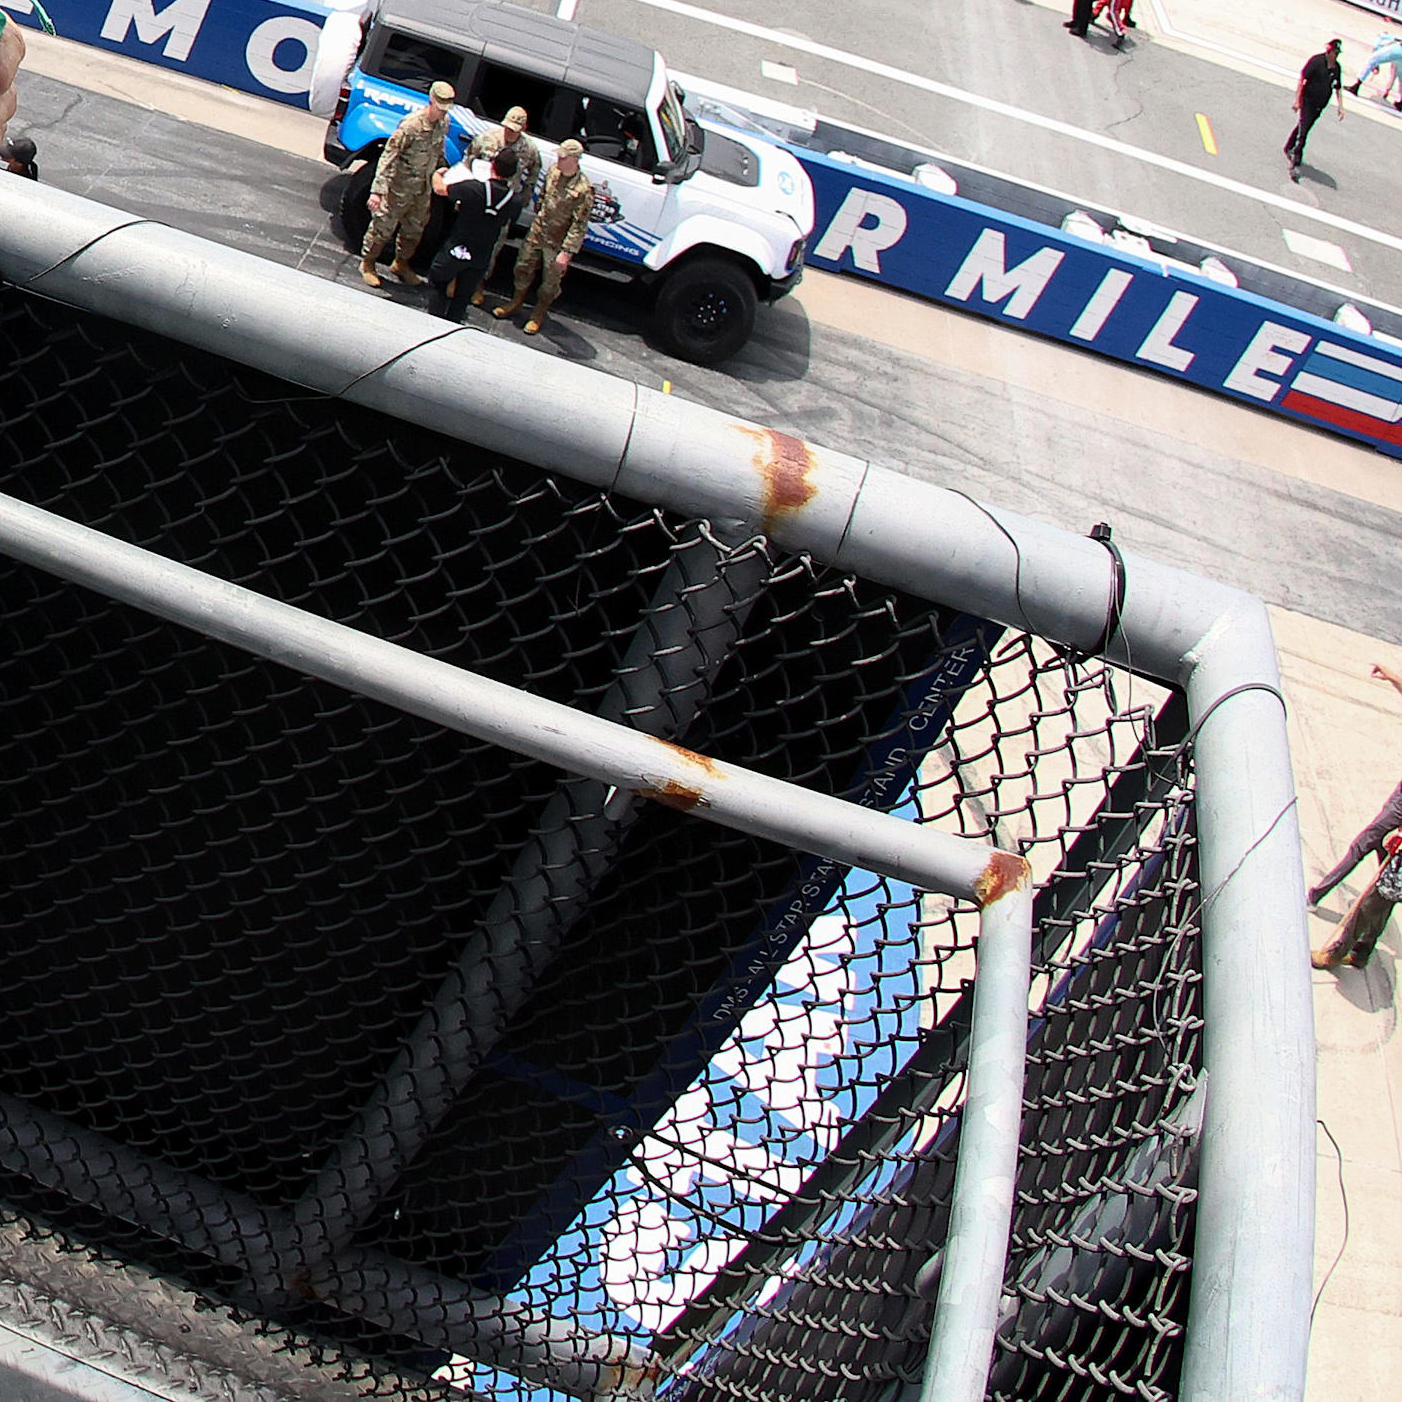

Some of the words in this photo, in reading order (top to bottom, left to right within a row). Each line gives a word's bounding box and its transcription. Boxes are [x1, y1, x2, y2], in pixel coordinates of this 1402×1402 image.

[356, 79, 428, 112] RAPT
[944, 227, 1313, 402] MILE
[908, 645, 977, 732] CENTER
